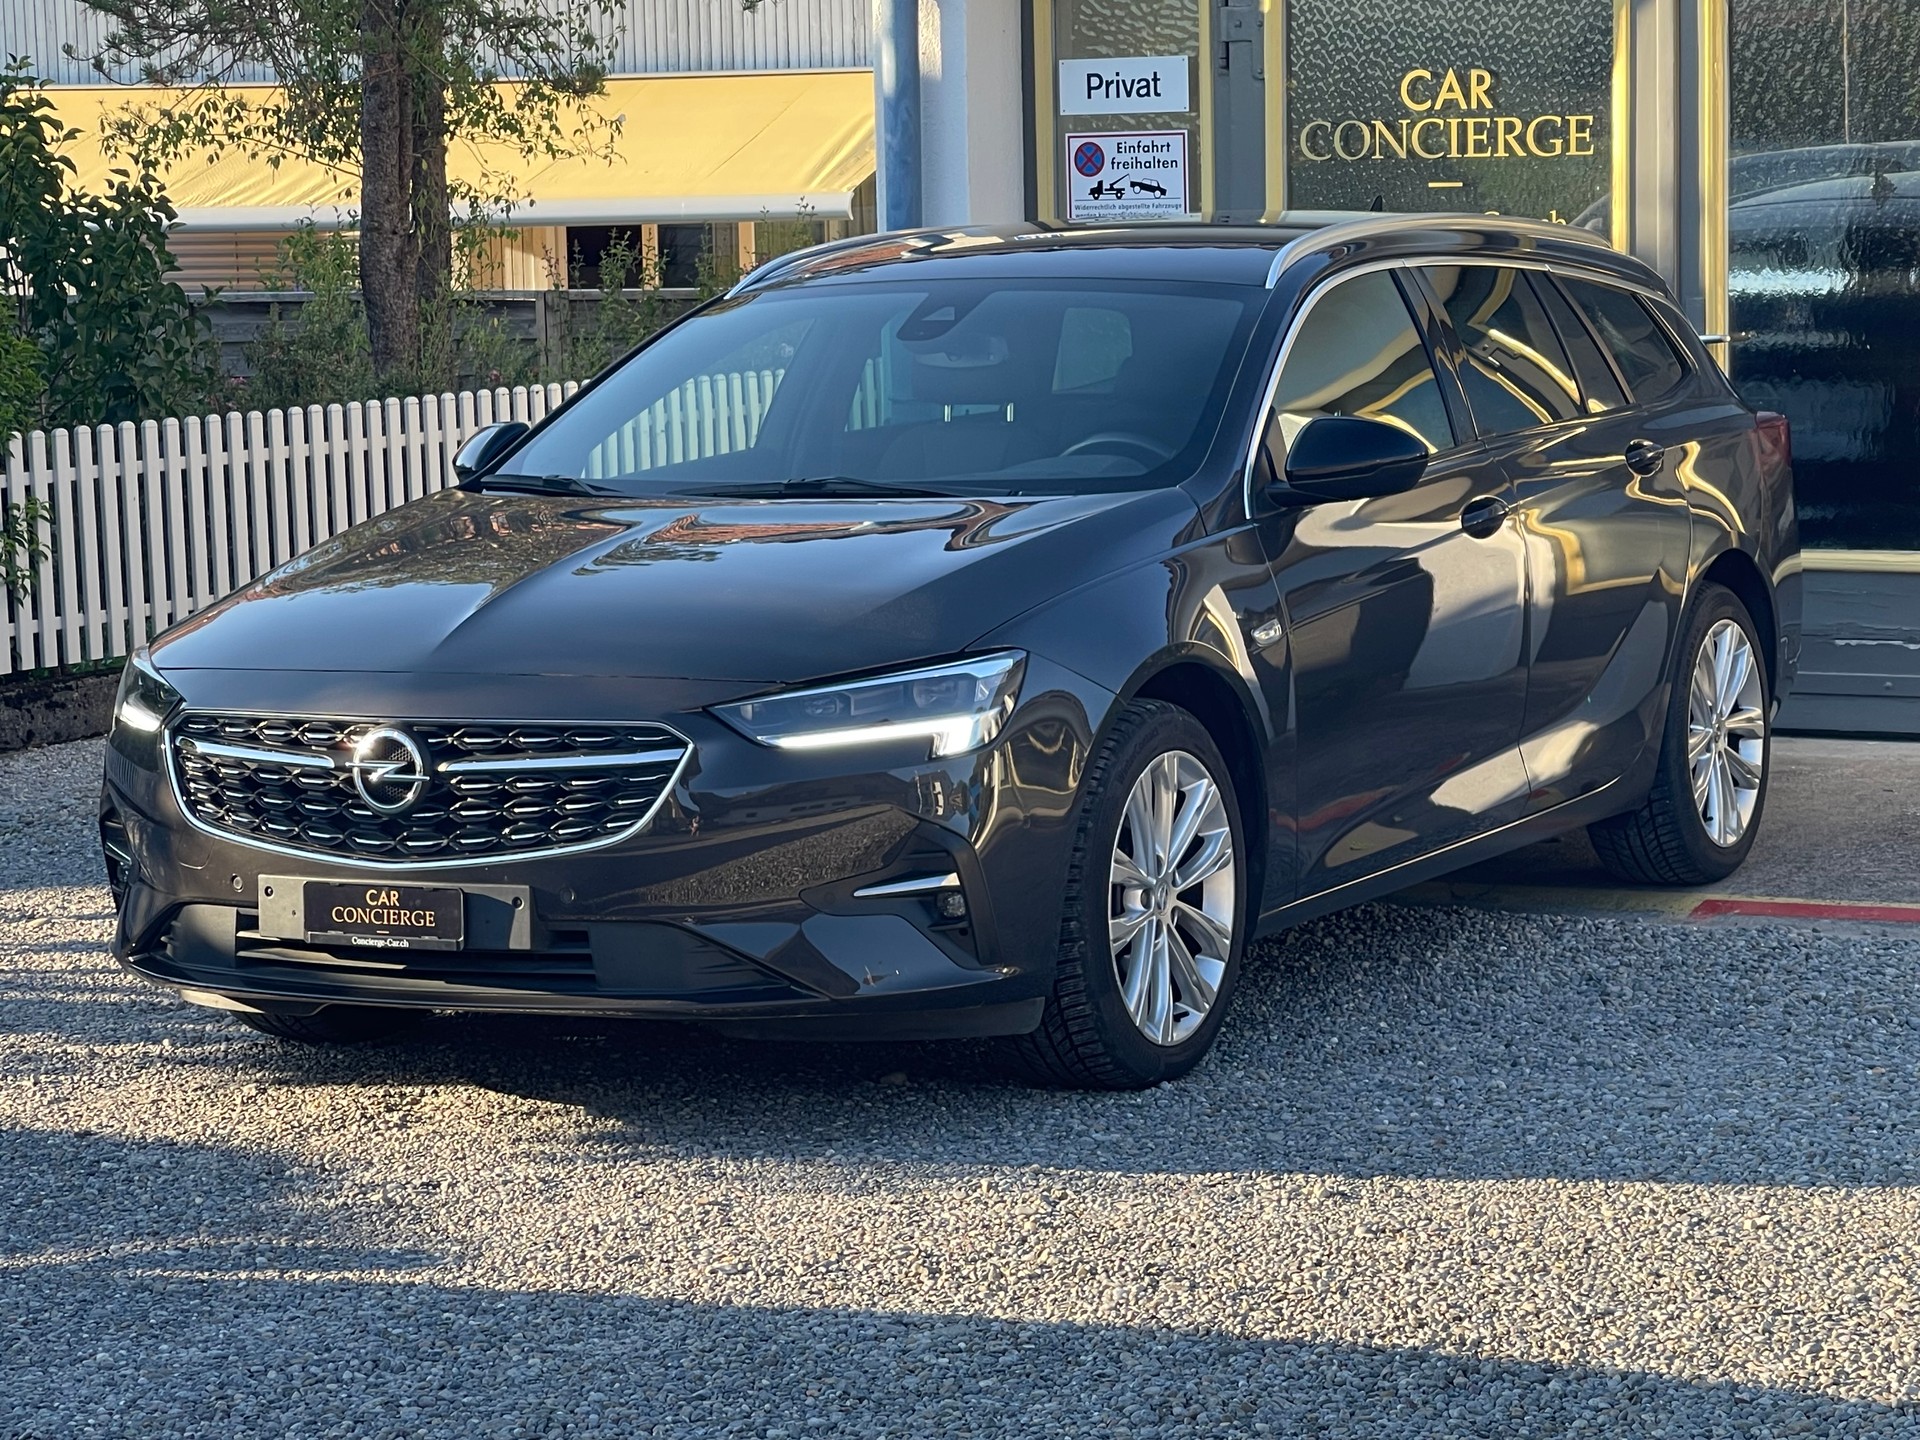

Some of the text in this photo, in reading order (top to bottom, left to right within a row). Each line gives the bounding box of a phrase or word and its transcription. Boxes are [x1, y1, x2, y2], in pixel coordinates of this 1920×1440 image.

[1086, 71, 1161, 99] Privat
[1400, 67, 1493, 111] CAR
[1116, 140, 1171, 154] Einfahrt
[1300, 115, 1595, 162] CONCIERGE
[1111, 156, 1178, 170] freihalten
[1074, 203, 1117, 211] Widerrechtlich
[1118, 203, 1150, 211] abgestellte
[366, 889, 400, 907] CAR
[331, 906, 436, 927] CONCIERGE
[351, 936, 409, 948] Concierge-Car.ch
